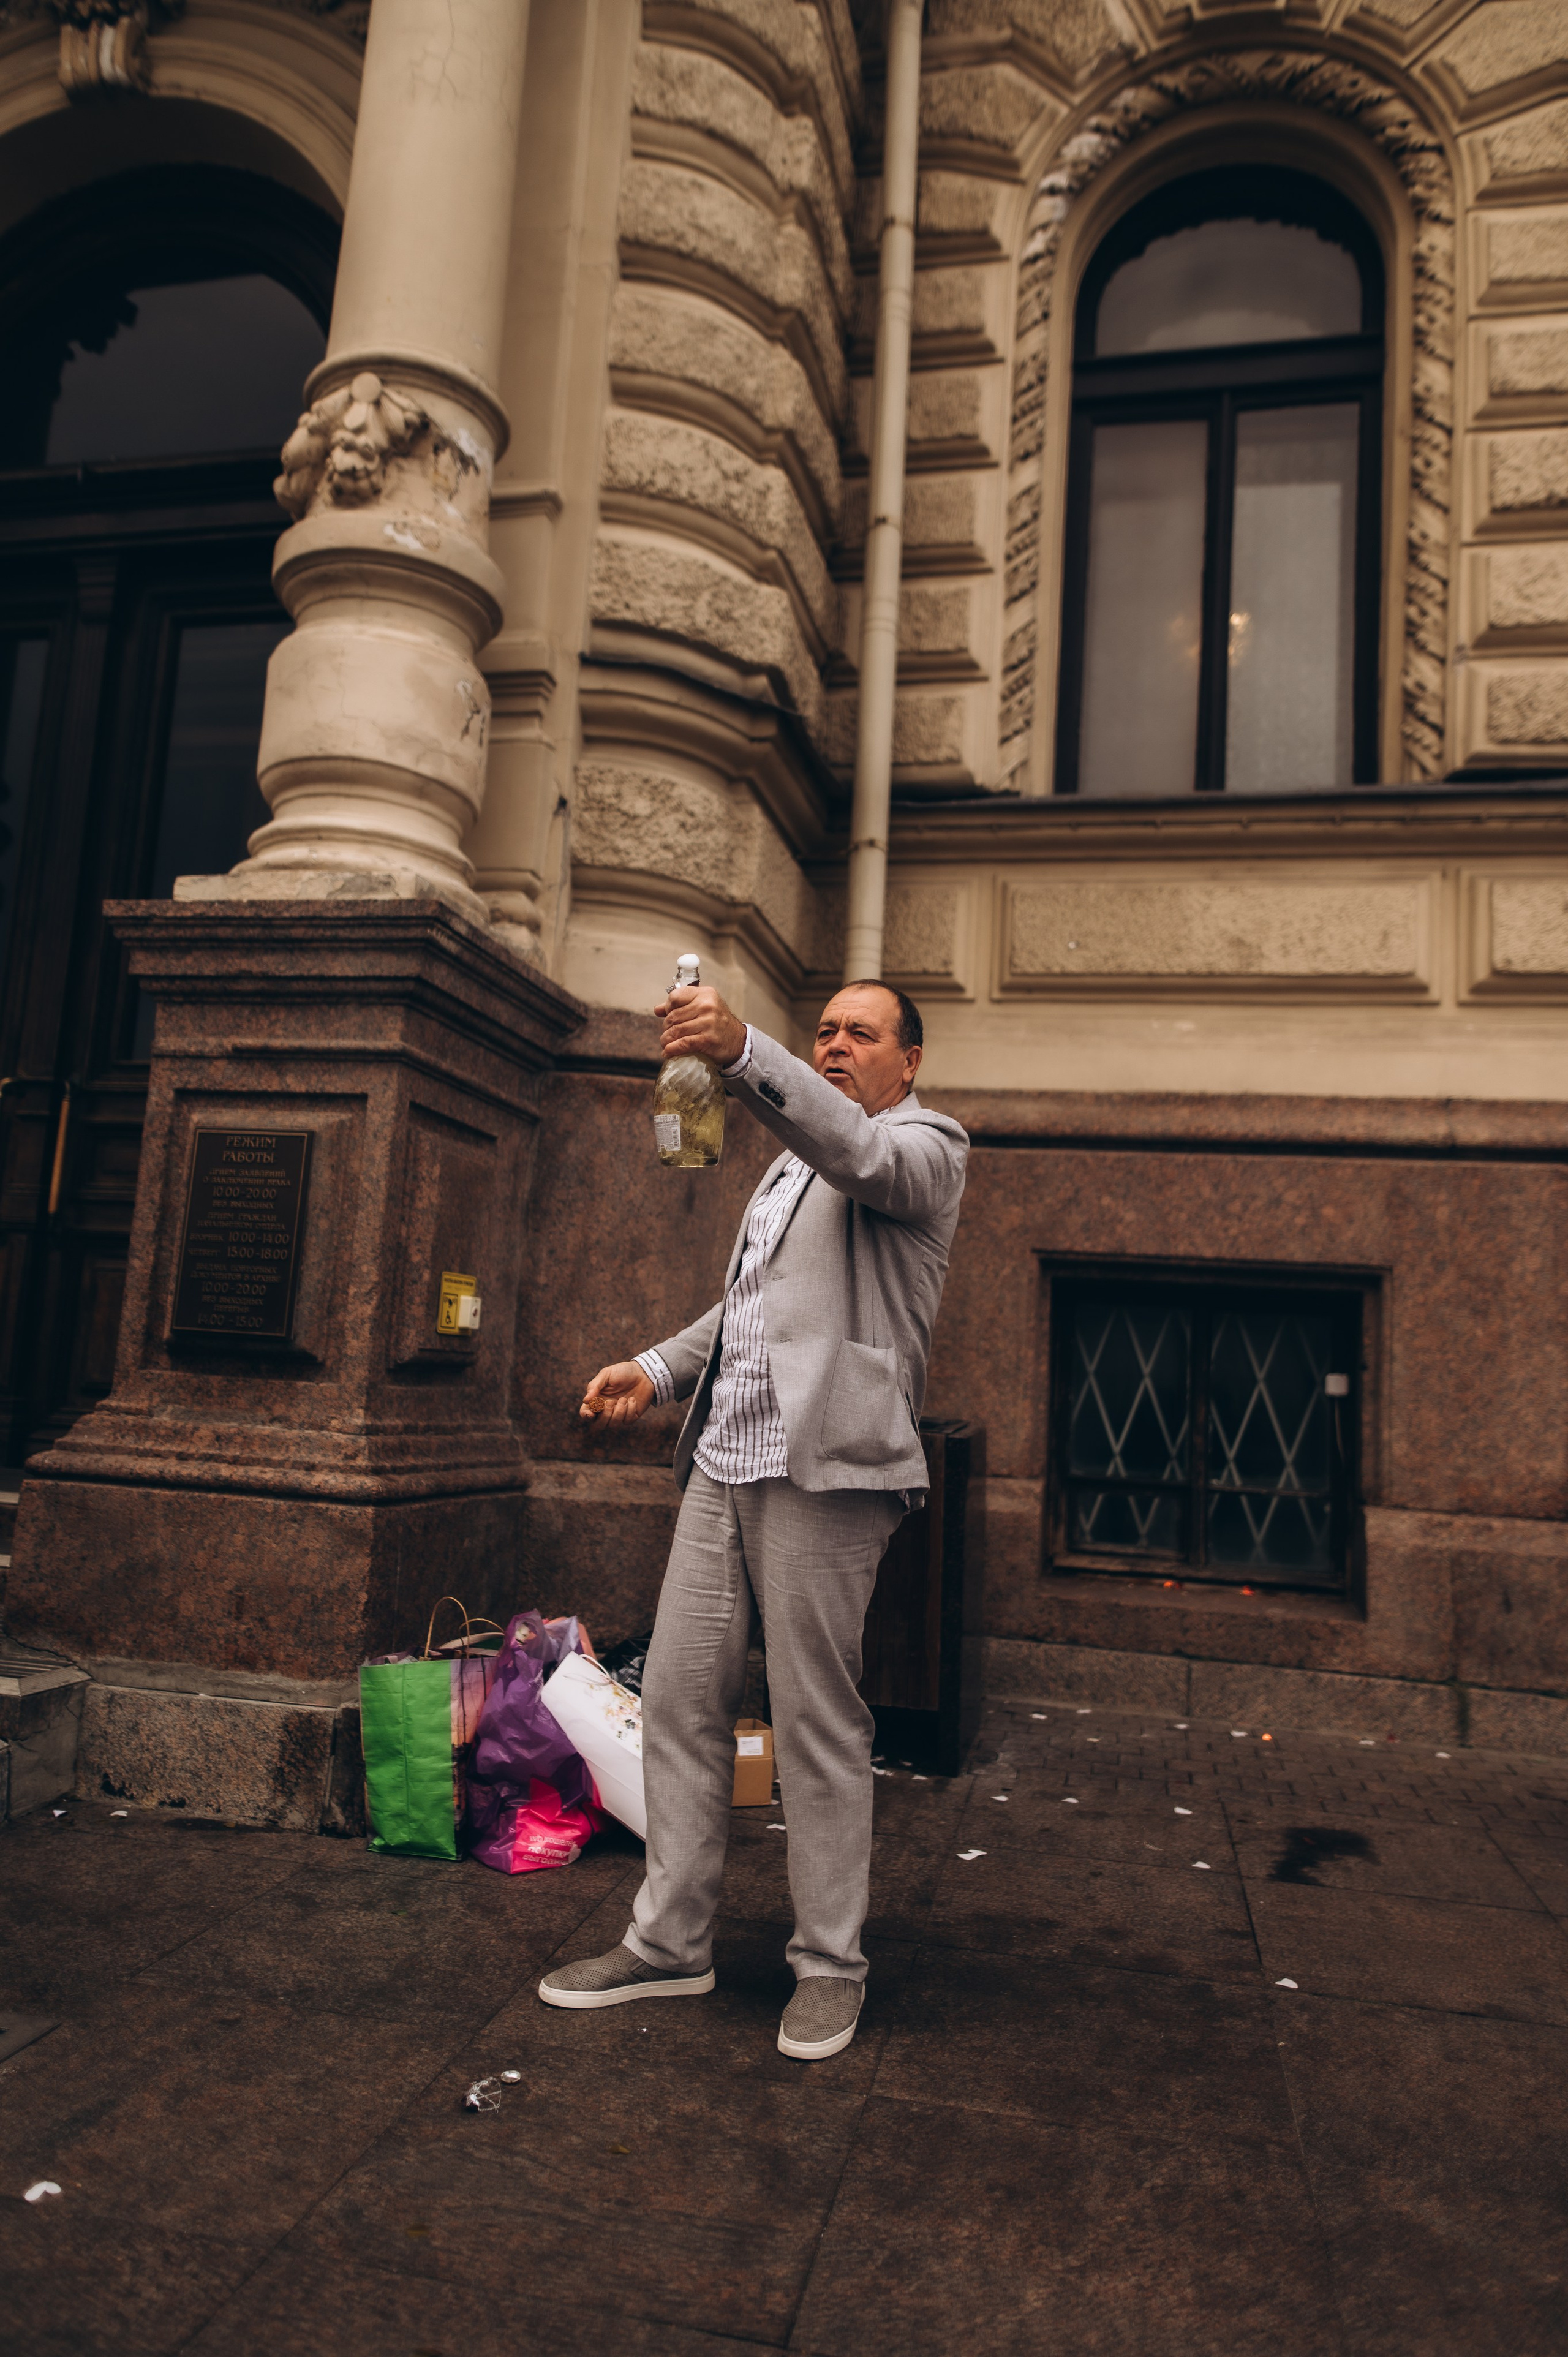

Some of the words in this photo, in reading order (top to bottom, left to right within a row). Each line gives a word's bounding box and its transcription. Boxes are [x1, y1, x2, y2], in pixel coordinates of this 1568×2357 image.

[225, 1136, 276, 1148] РЕЖИМ
[222, 1150, 274, 1163] РАБОТЫ
[230, 1200, 275, 1210] ВЫХОДНЫХ
[238, 1213, 277, 1221] ГРАЖДАН
[219, 1296, 263, 1305] ВЫХОДНЫХ
